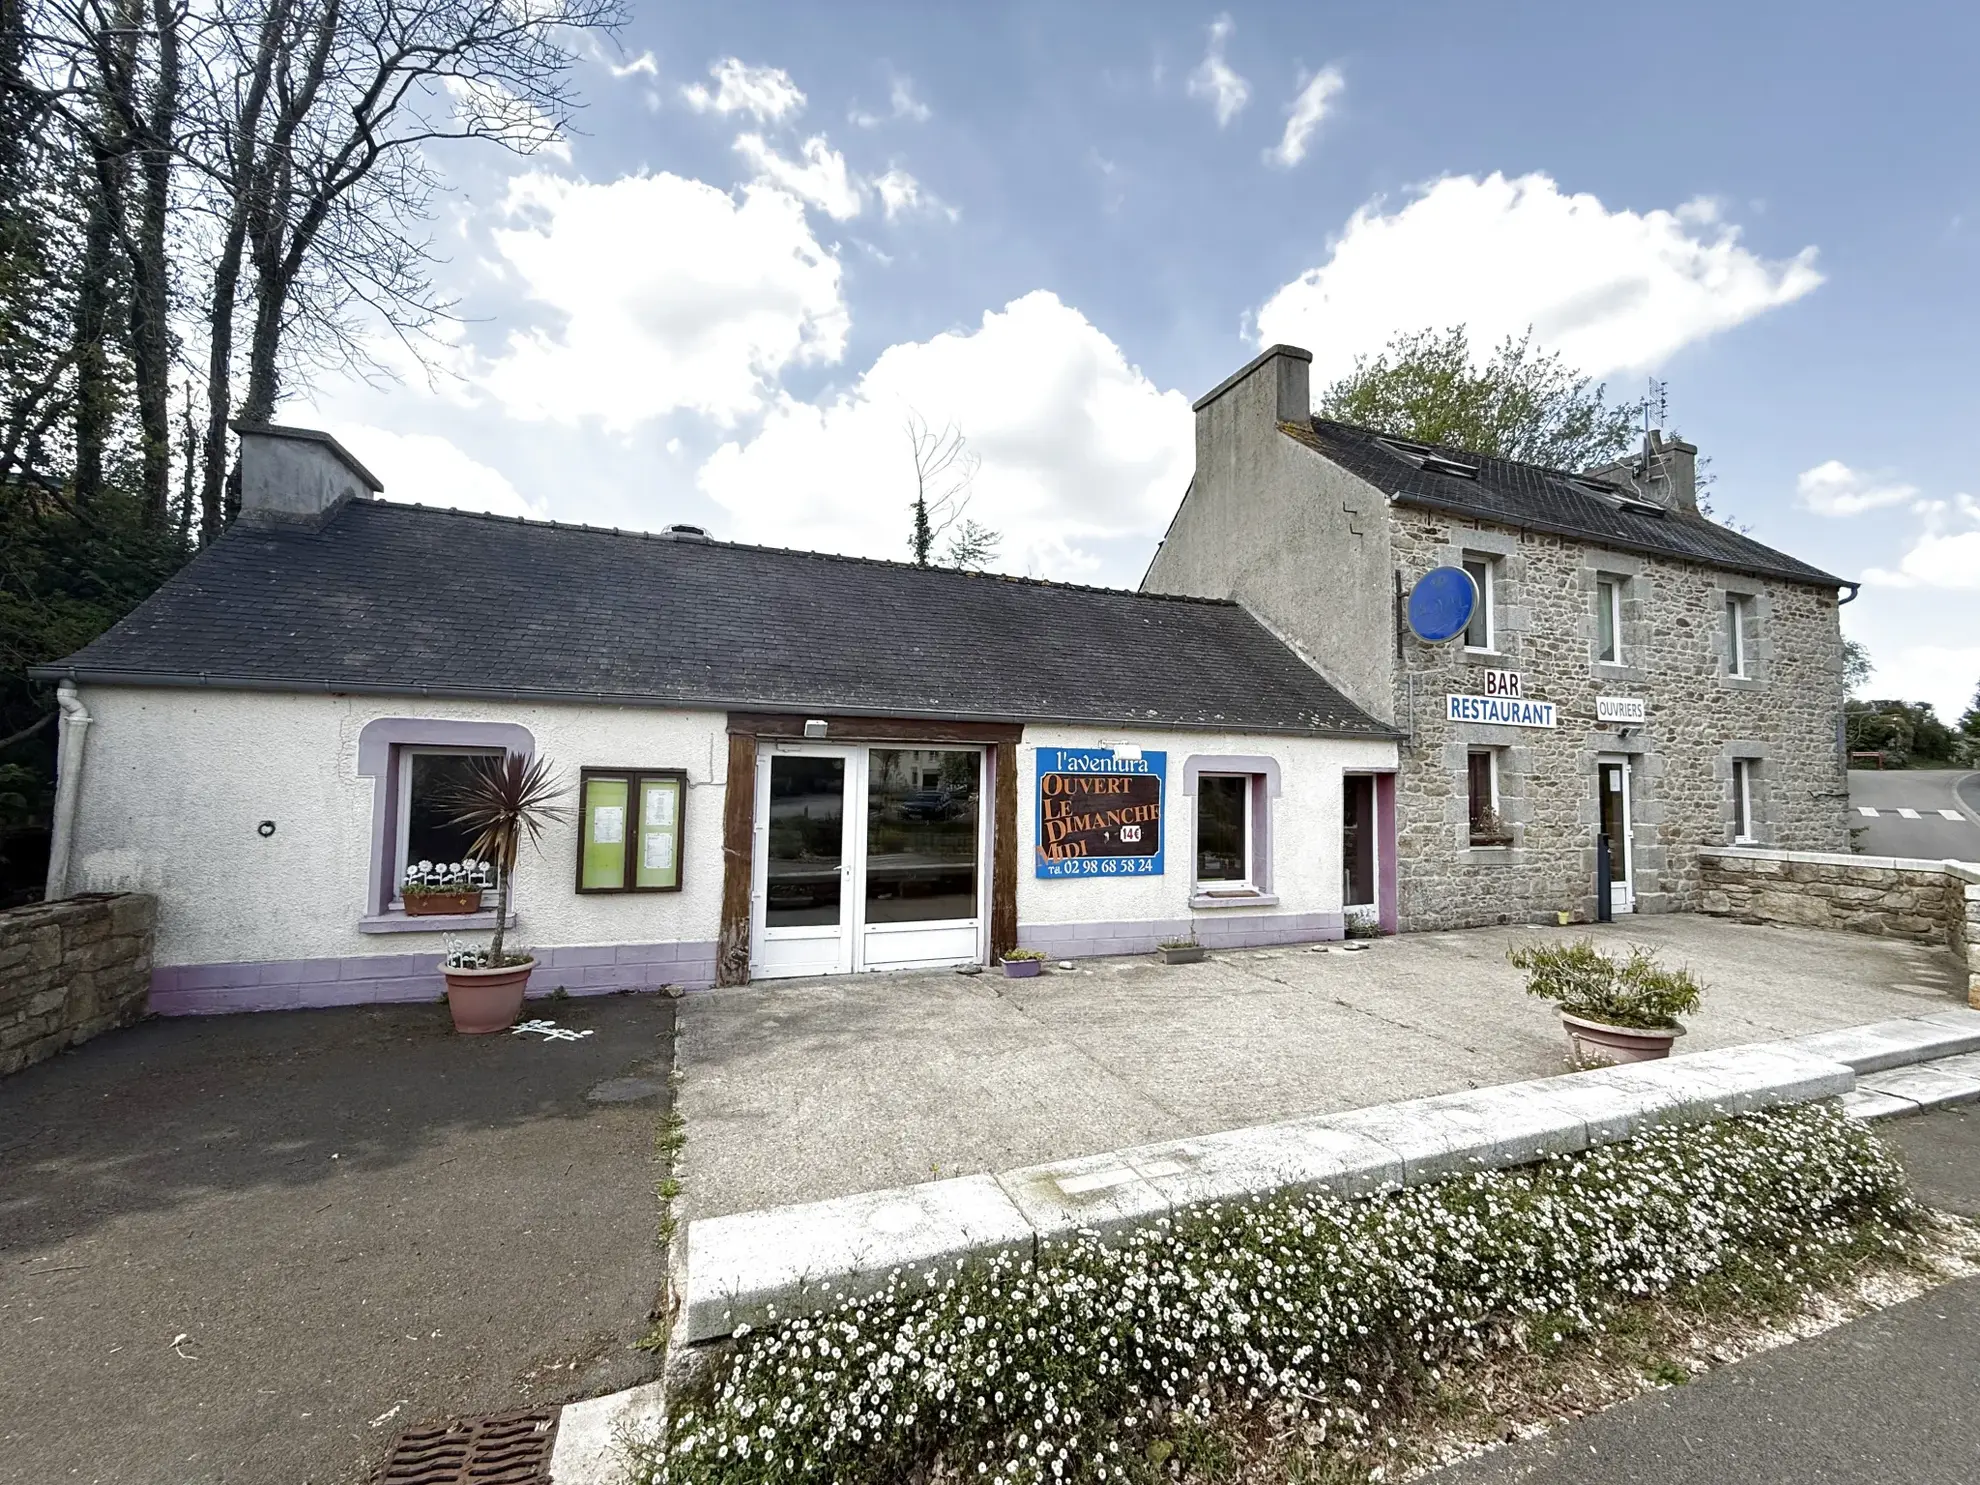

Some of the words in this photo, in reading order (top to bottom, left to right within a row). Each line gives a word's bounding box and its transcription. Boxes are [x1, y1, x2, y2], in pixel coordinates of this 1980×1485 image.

[1487, 671, 1519, 696] BAR
[1451, 697, 1552, 725] RESTAURANT
[1599, 701, 1643, 718] OUVRIERS
[1056, 751, 1148, 772] l'aventura
[1042, 774, 1132, 796] OUVERT
[1043, 799, 1073, 820] LE
[1045, 804, 1160, 843] DIMANCHE
[1122, 827, 1139, 840] 14€
[1064, 860, 1080, 874] 02
[1082, 860, 1098, 873] 98
[1101, 859, 1117, 873] 68
[1120, 859, 1135, 872] 58
[1137, 858, 1153, 872] 24
